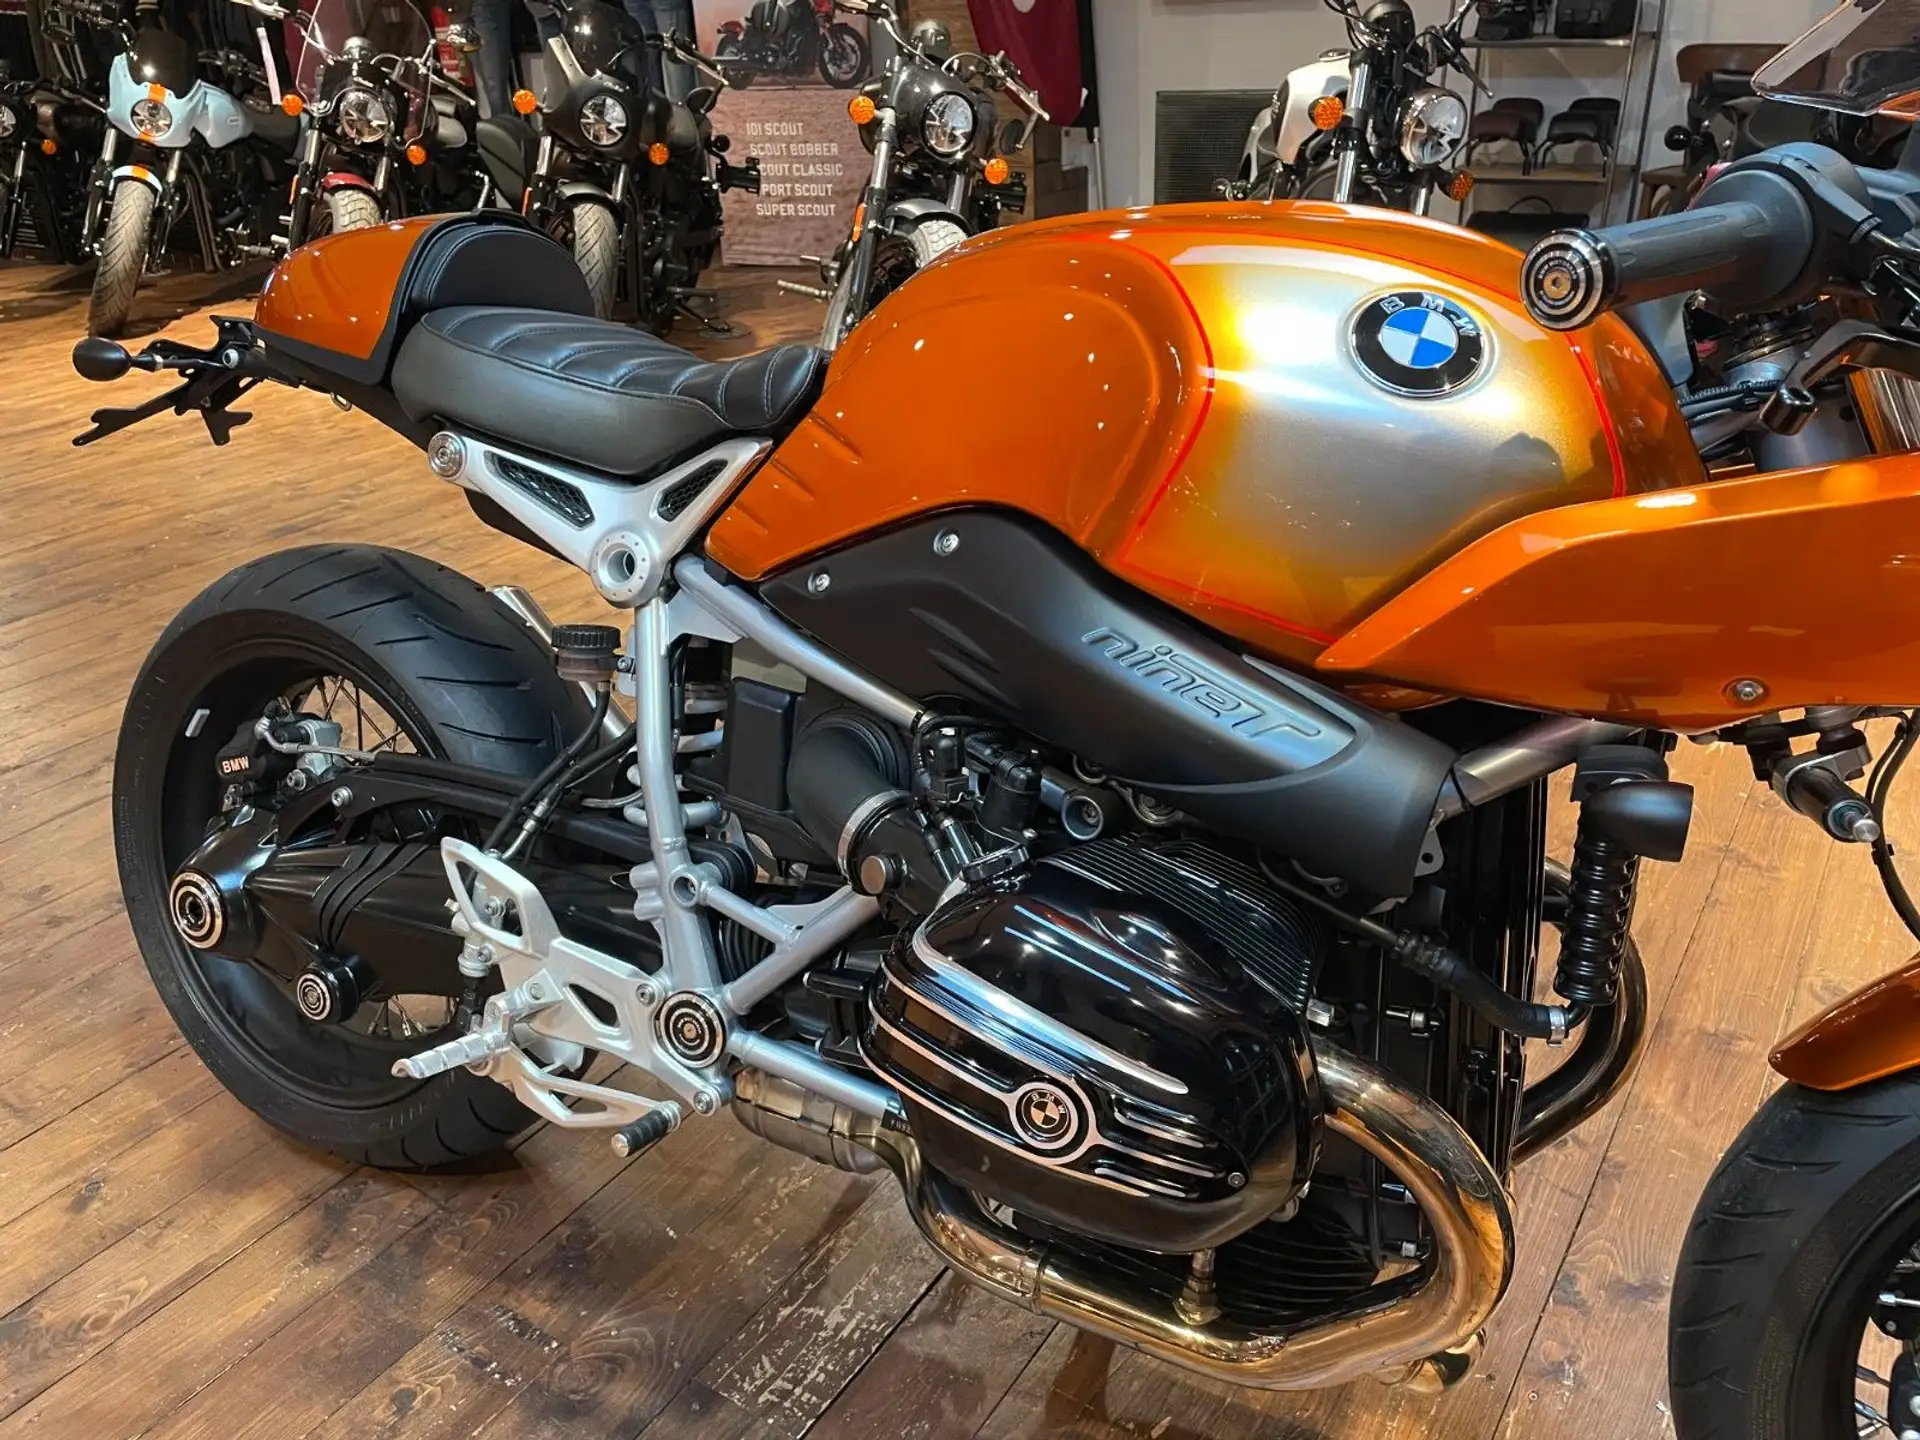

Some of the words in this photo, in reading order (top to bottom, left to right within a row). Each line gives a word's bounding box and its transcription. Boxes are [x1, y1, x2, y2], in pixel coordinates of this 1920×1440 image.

[764, 122, 804, 136] SCOUT
[749, 143, 787, 155] SCOUT
[789, 143, 839, 155] BOBBER
[759, 163, 790, 176] COUT
[792, 163, 843, 176] CLASSIC
[761, 183, 791, 196] PORT
[794, 183, 833, 196] SCOUT
[756, 203, 795, 216] SUPER
[797, 203, 836, 216] SCOUT
[1379, 292, 1477, 337] BMW
[222, 755, 250, 773] BMW
[1031, 1091, 1068, 1115] BMW
